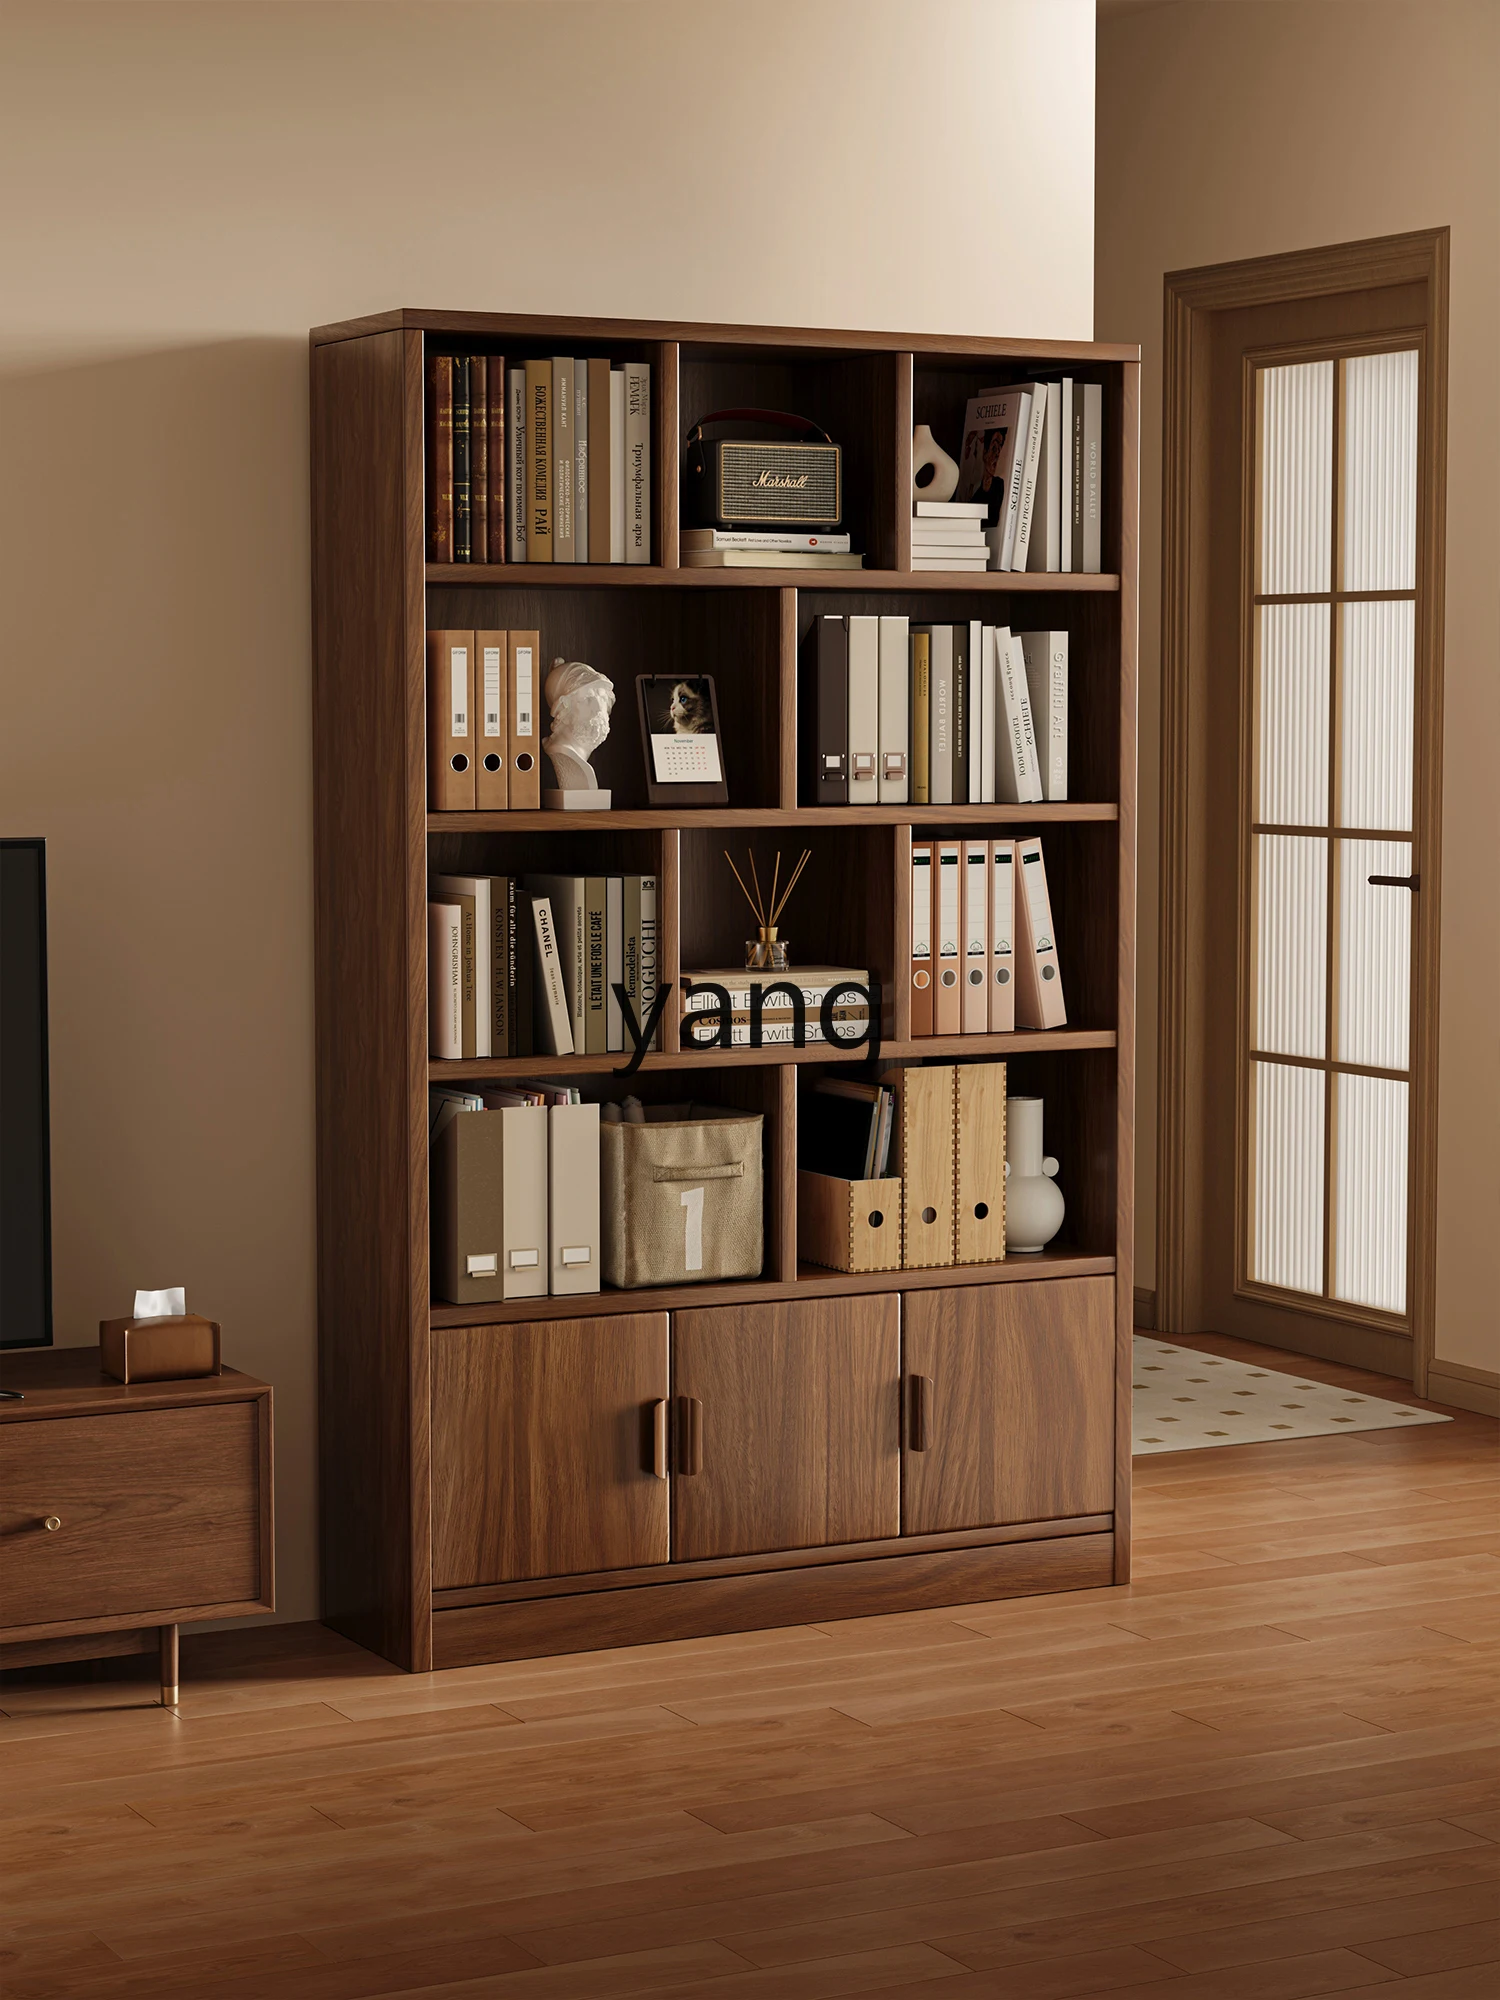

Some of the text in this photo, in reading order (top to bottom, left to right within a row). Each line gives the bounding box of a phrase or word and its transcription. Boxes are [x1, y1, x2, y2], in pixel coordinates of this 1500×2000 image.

[976, 404, 1006, 419] SCHIELE
[516, 426, 525, 464] Уличный
[534, 386, 550, 535] БОЖЕСТВЕННАЯ КОМЕДИЯ РАЙ
[576, 440, 587, 493] Избранное
[752, 470, 809, 488] Marshall
[1010, 459, 1022, 511] SCHIELE
[516, 484, 522, 494] по
[632, 443, 644, 546] Триумфальная арка
[1023, 478, 1032, 520] PICOULT
[516, 525, 525, 542] Боб
[1053, 652, 1064, 738] Graffiti Art
[466, 912, 472, 920] At
[495, 908, 503, 959] KONSTEN
[539, 909, 553, 958] CHANEL
[589, 911, 602, 931] CAFÉ
[591, 932, 602, 942] LE
[591, 943, 602, 960] FOIS
[464, 956, 472, 982] Joshua
[591, 962, 602, 978] UNE
[626, 936, 636, 998] Remodelista
[642, 919, 656, 1016] NOGUCHI
[589, 979, 602, 1001] ÉTAIT
[681, 1187, 704, 1270] 1
